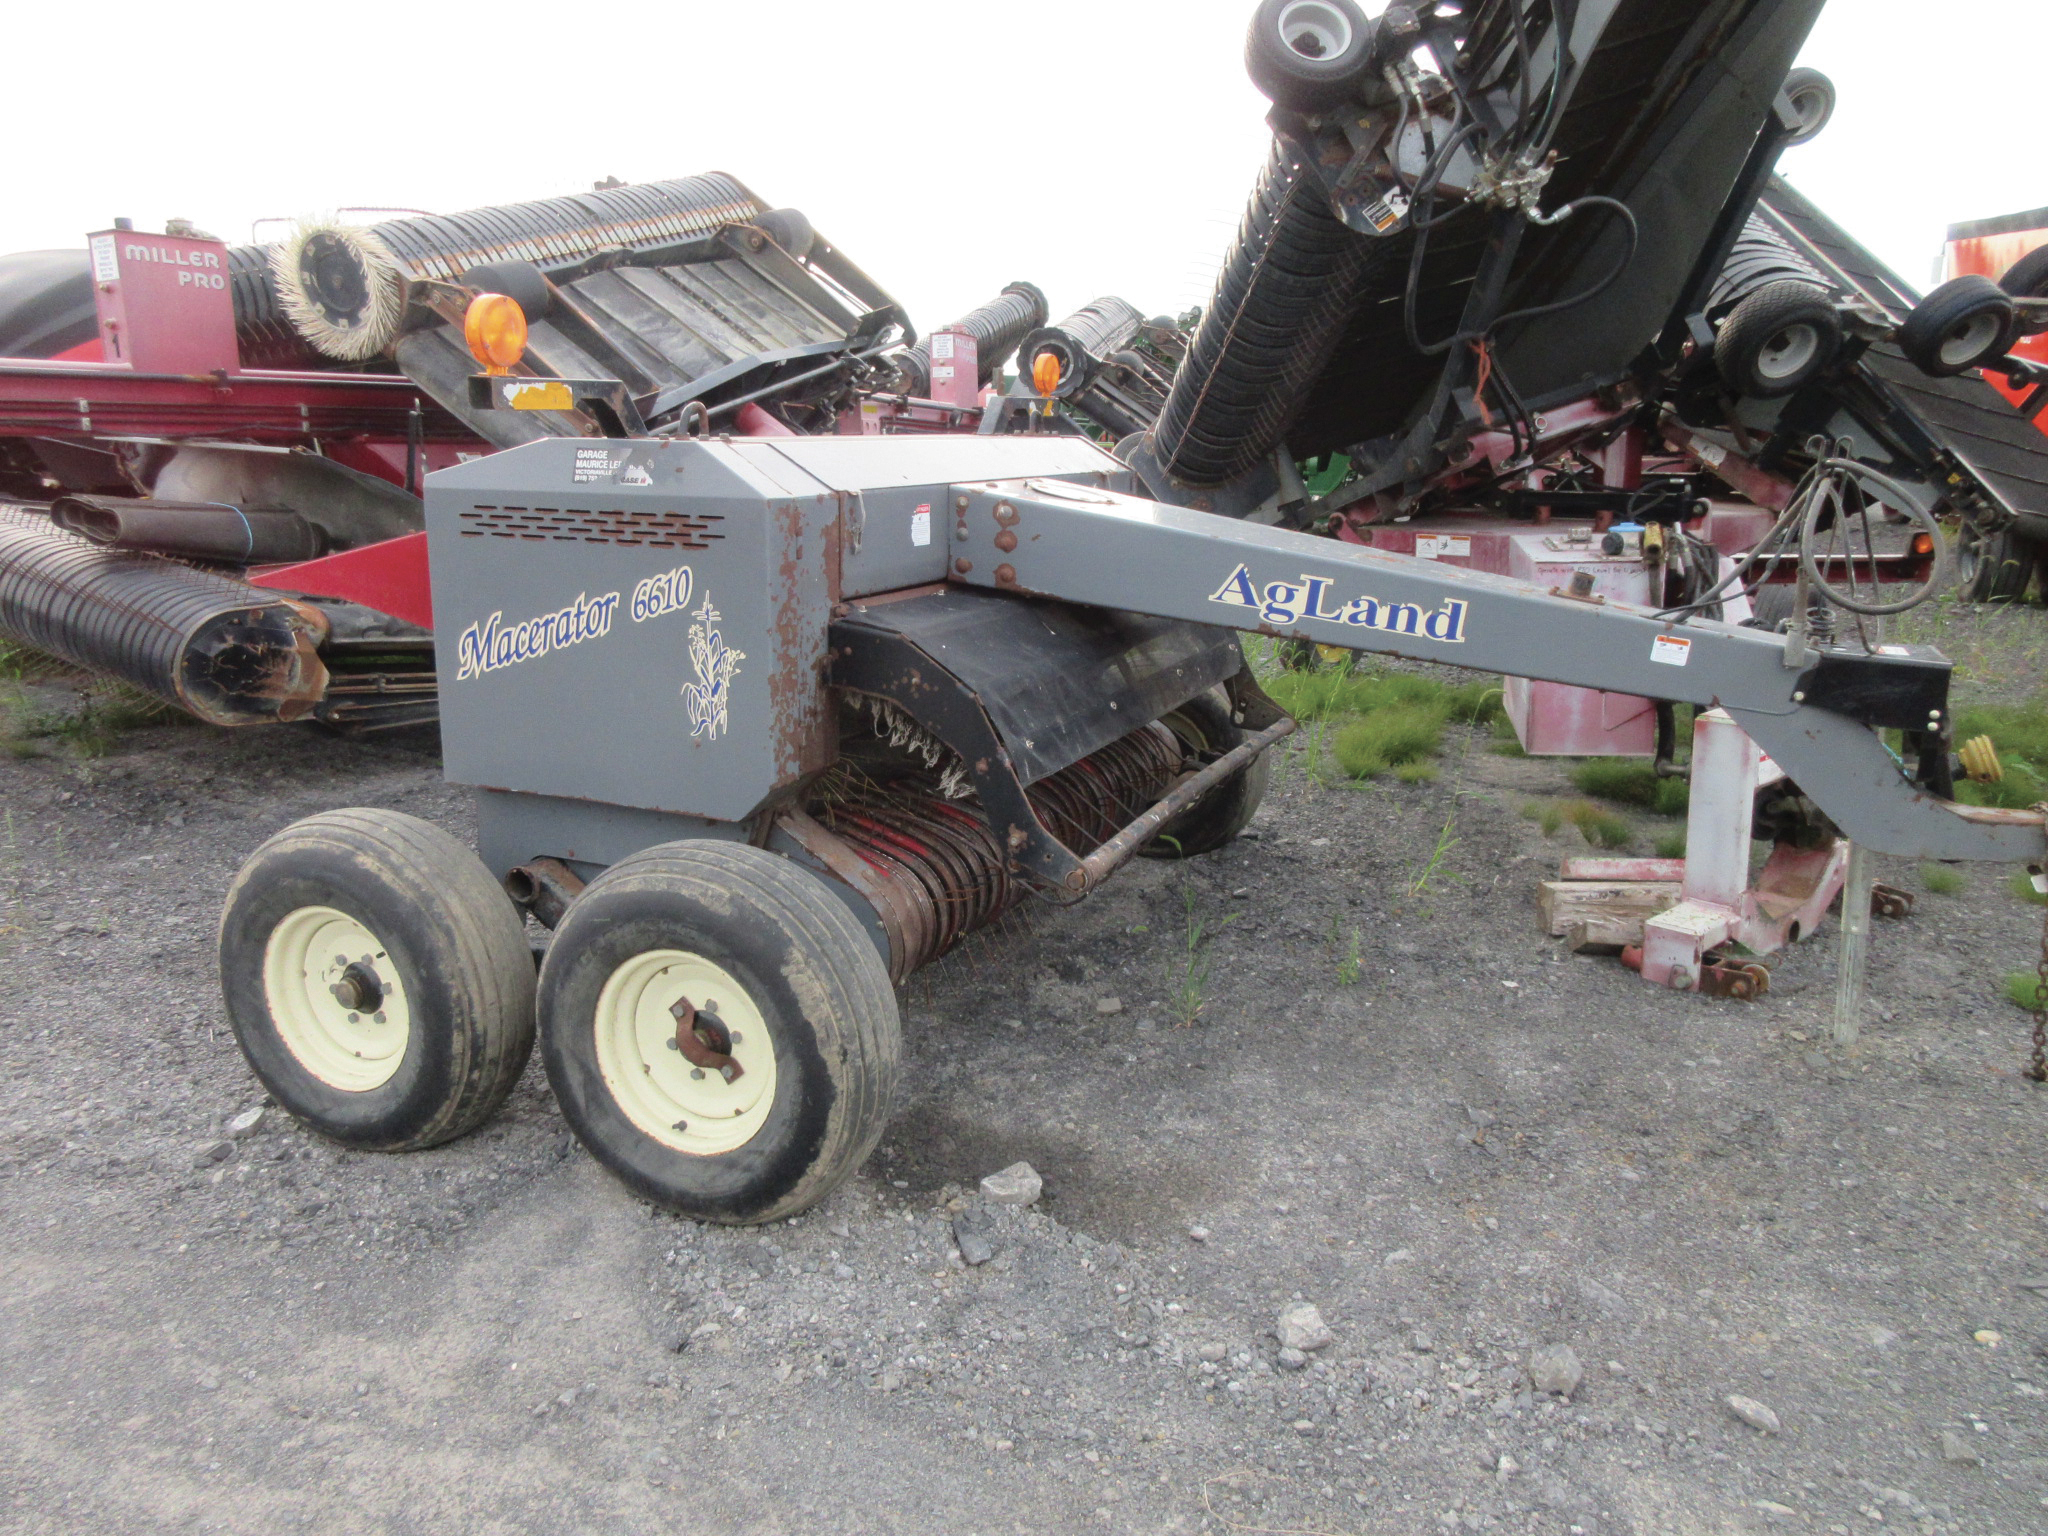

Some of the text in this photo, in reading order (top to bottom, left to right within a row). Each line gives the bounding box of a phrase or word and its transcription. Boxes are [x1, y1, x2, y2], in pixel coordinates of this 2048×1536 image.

[125, 244, 220, 269] MILLER
[178, 270, 225, 290] PRO
[575, 460, 608, 469] MAURICE
[577, 450, 608, 460] GARAGE
[1208, 562, 1469, 643] AgLand
[456, 566, 694, 681] Macerator 6610
